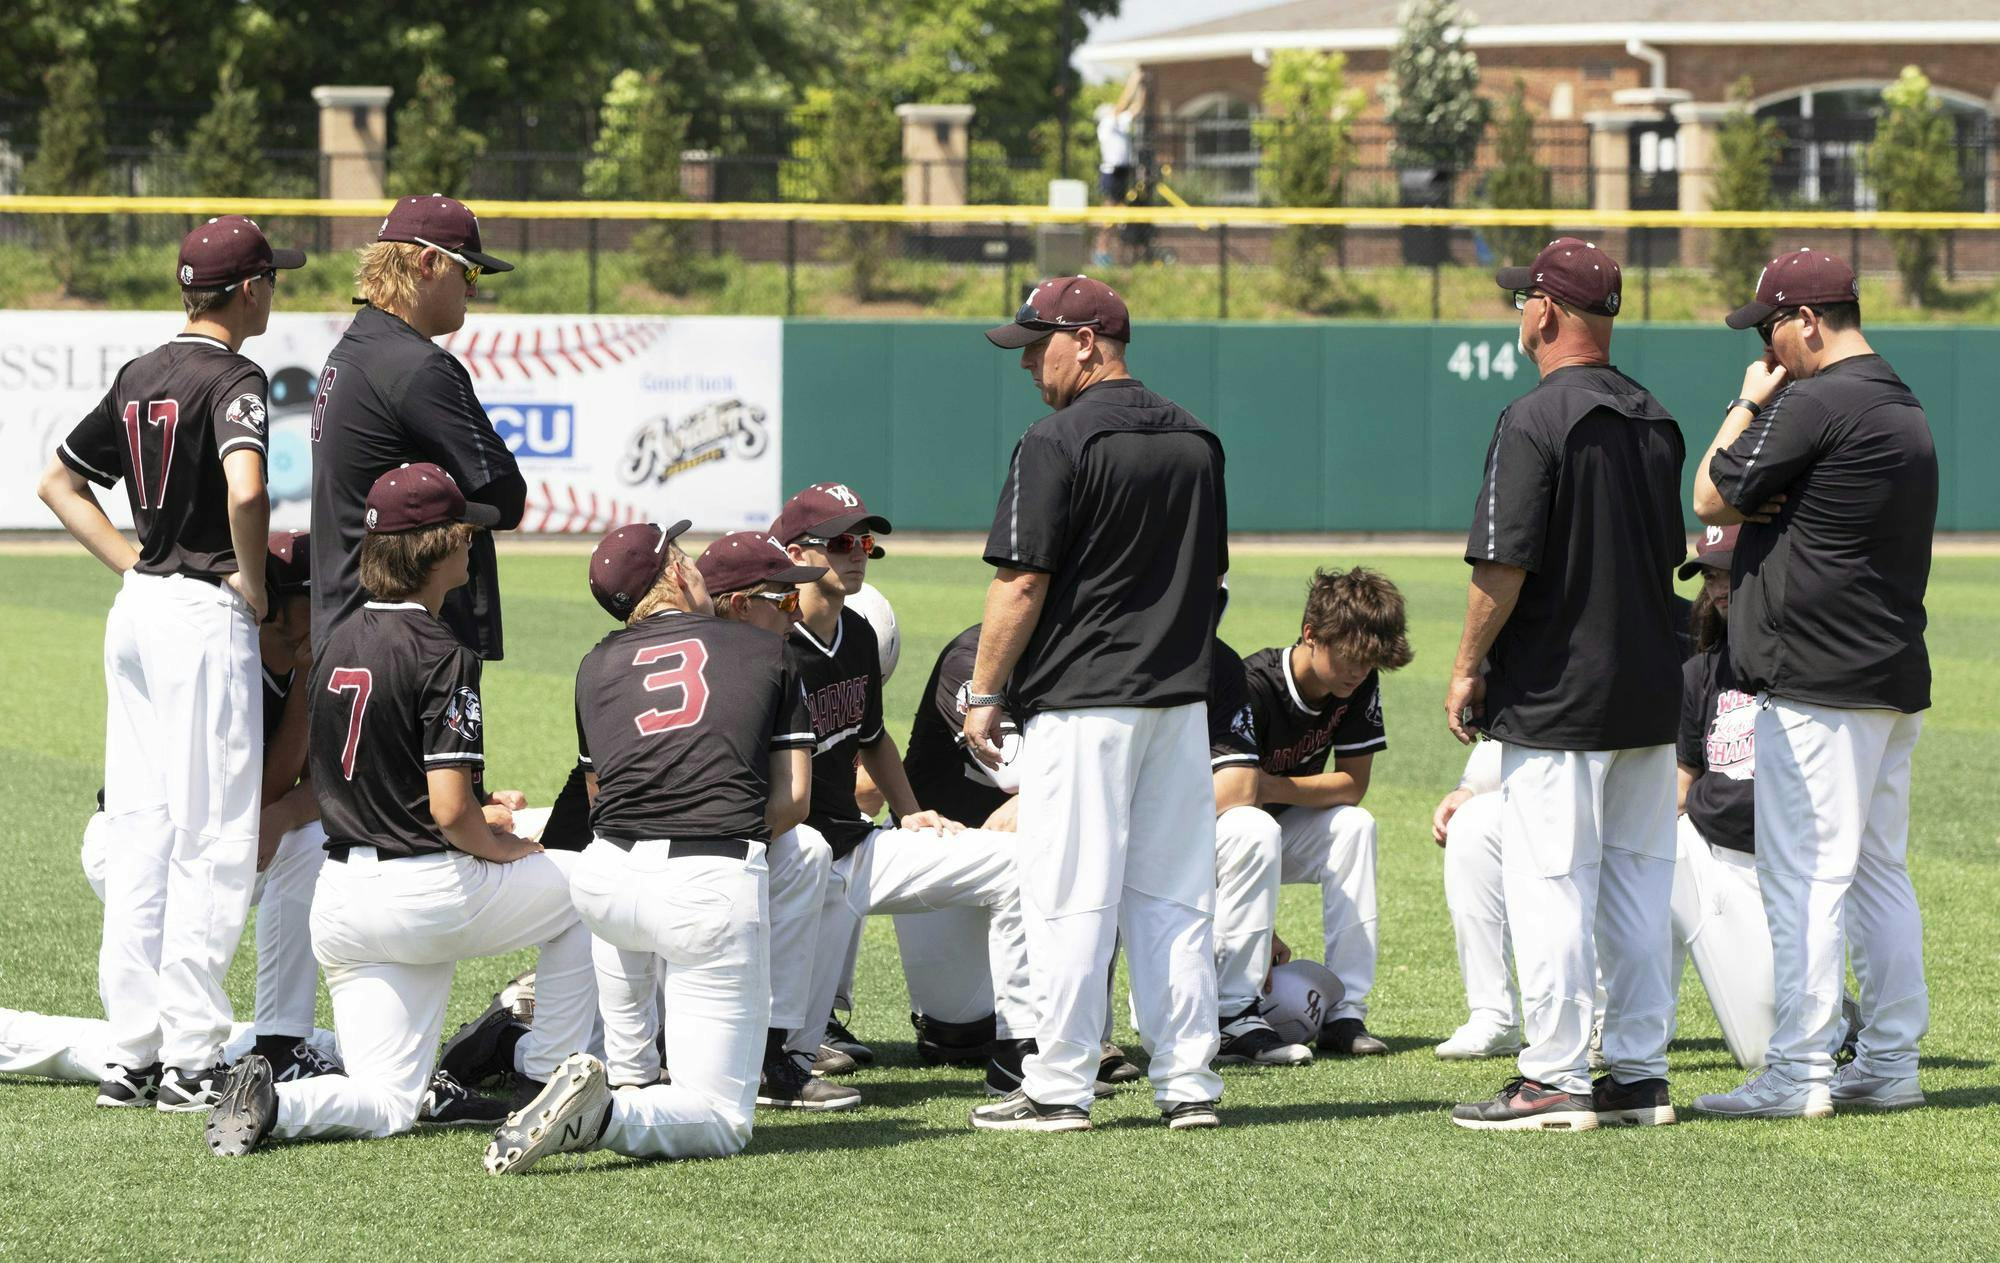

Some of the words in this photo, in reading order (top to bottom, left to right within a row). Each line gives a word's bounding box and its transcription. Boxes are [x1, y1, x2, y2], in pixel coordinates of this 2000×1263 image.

[1448, 341, 1518, 381] 414
[123, 399, 179, 510] 17
[487, 406, 572, 454] CU
[327, 667, 373, 781] 7
[632, 638, 710, 737] 3
